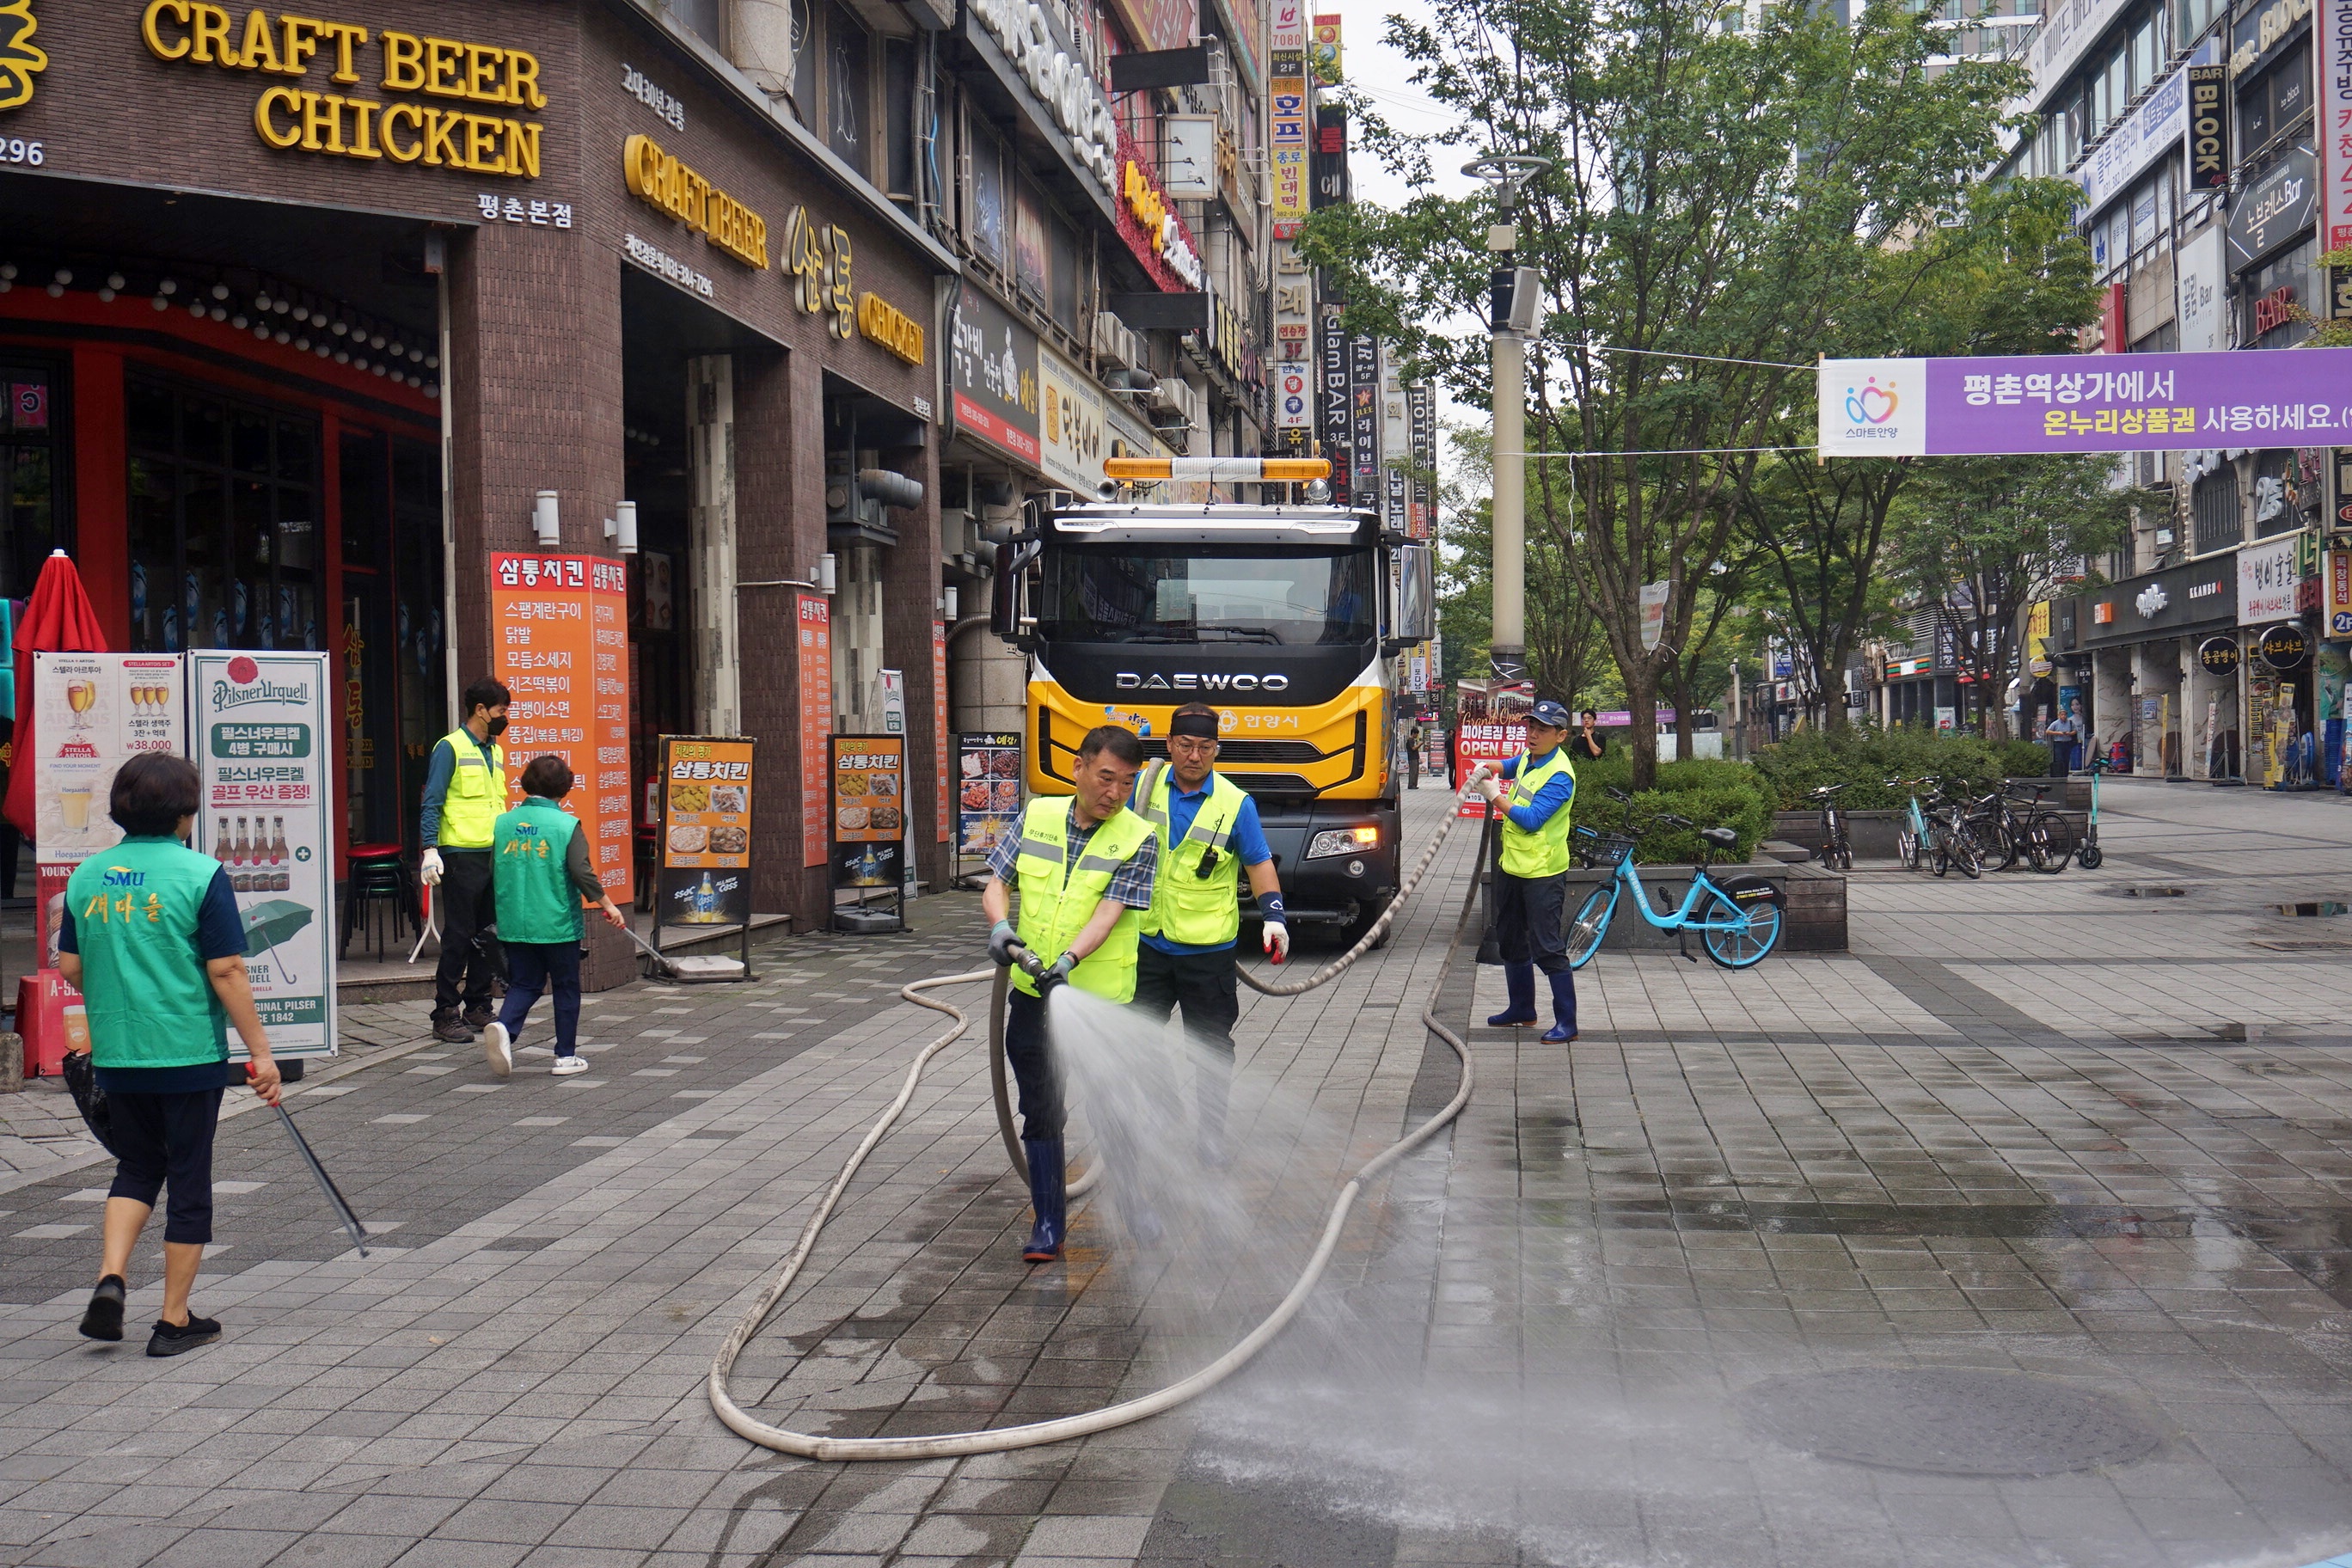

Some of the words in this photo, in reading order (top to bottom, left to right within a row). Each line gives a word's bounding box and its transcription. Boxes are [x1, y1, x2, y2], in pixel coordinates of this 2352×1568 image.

[1272, 34, 1301, 46] 7080
[141, 0, 368, 84] CRAFT
[380, 30, 548, 111] BEER
[1272, 52, 1302, 61] 최신시설
[1280, 64, 1295, 72] 2F
[2190, 68, 2224, 82] BAR
[1274, 95, 1302, 143] 호프
[255, 86, 544, 179] CHICKEN
[2195, 85, 2220, 173] BLOCK
[1319, 126, 1344, 153] 룸
[1276, 151, 1303, 163] 종로
[1280, 166, 1299, 209] 빈대떡
[2210, 174, 2227, 186] 4F
[624, 133, 711, 233] CRAFT
[707, 188, 769, 271] BEER
[478, 193, 573, 229] 평촌본점
[1278, 247, 1306, 315] 노래
[2200, 285, 2213, 308] Bar
[2254, 285, 2293, 336] BAR
[858, 291, 924, 366] CHICKEN
[1279, 325, 1308, 338] 연습장
[1284, 342, 1303, 358] 3F
[1326, 316, 1345, 370] Glam
[1963, 370, 2176, 407] 평촌역상가에서
[1326, 373, 1347, 426] BAR
[1355, 406, 1375, 419] JLEE
[2043, 407, 2196, 437] 온누리상품권
[1330, 432, 1345, 443] 3F
[1845, 427, 1898, 439] 스마트안양
[1357, 419, 1373, 465] 라이브
[498, 558, 585, 587] 삼통치킨
[591, 562, 624, 592] 삼통치킨
[505, 602, 582, 620] 스팸계란구이
[801, 600, 827, 622] 삼통치킨
[505, 627, 531, 644] 닭발
[2263, 640, 2304, 653] 샤브샤브
[506, 652, 572, 670] 모듬소세지
[2202, 648, 2239, 665] 통골뱅이
[508, 677, 570, 694] 치즈떡볶이
[1116, 673, 1289, 692] DAEWOO
[212, 679, 262, 713] Pilsner
[260, 678, 308, 707] Urquell
[507, 701, 571, 719] 골뱅이소면
[128, 720, 150, 728] 스텔라
[150, 720, 171, 728] 생맥주
[1243, 714, 1298, 728] 안양시
[1462, 711, 1497, 727] Grand
[221, 726, 300, 740] 필스너우르켈
[508, 725, 584, 744] 똥집(볶음,튀김)
[1461, 726, 1504, 740] 피아트짐
[1506, 726, 1528, 741] 평촌
[229, 742, 250, 755] 4병
[254, 742, 293, 755] 구매시
[675, 744, 696, 758] 치킨의
[698, 744, 712, 759] 명가
[839, 742, 855, 752] 치킨의
[1461, 741, 1499, 756] OPEN
[1501, 741, 1527, 756] 특가
[837, 754, 899, 770] 삼통치킨
[217, 767, 304, 782] 필스너우르켈
[671, 761, 750, 781] 삼통치킨
[212, 785, 241, 800] 골프
[245, 784, 274, 799] 우산
[278, 784, 310, 799] 증정!
[515, 825, 538, 836] SMU
[504, 839, 551, 859] 새마을
[40, 867, 71, 878] YOURS
[101, 870, 145, 886] SMU
[1627, 870, 1649, 910] EVERYBIKE
[84, 891, 164, 923] 새마을
[245, 965, 269, 974] SNER
[248, 974, 272, 983] UELL
[285, 1000, 316, 1010] PILSER
[271, 1012, 294, 1022] 1842
